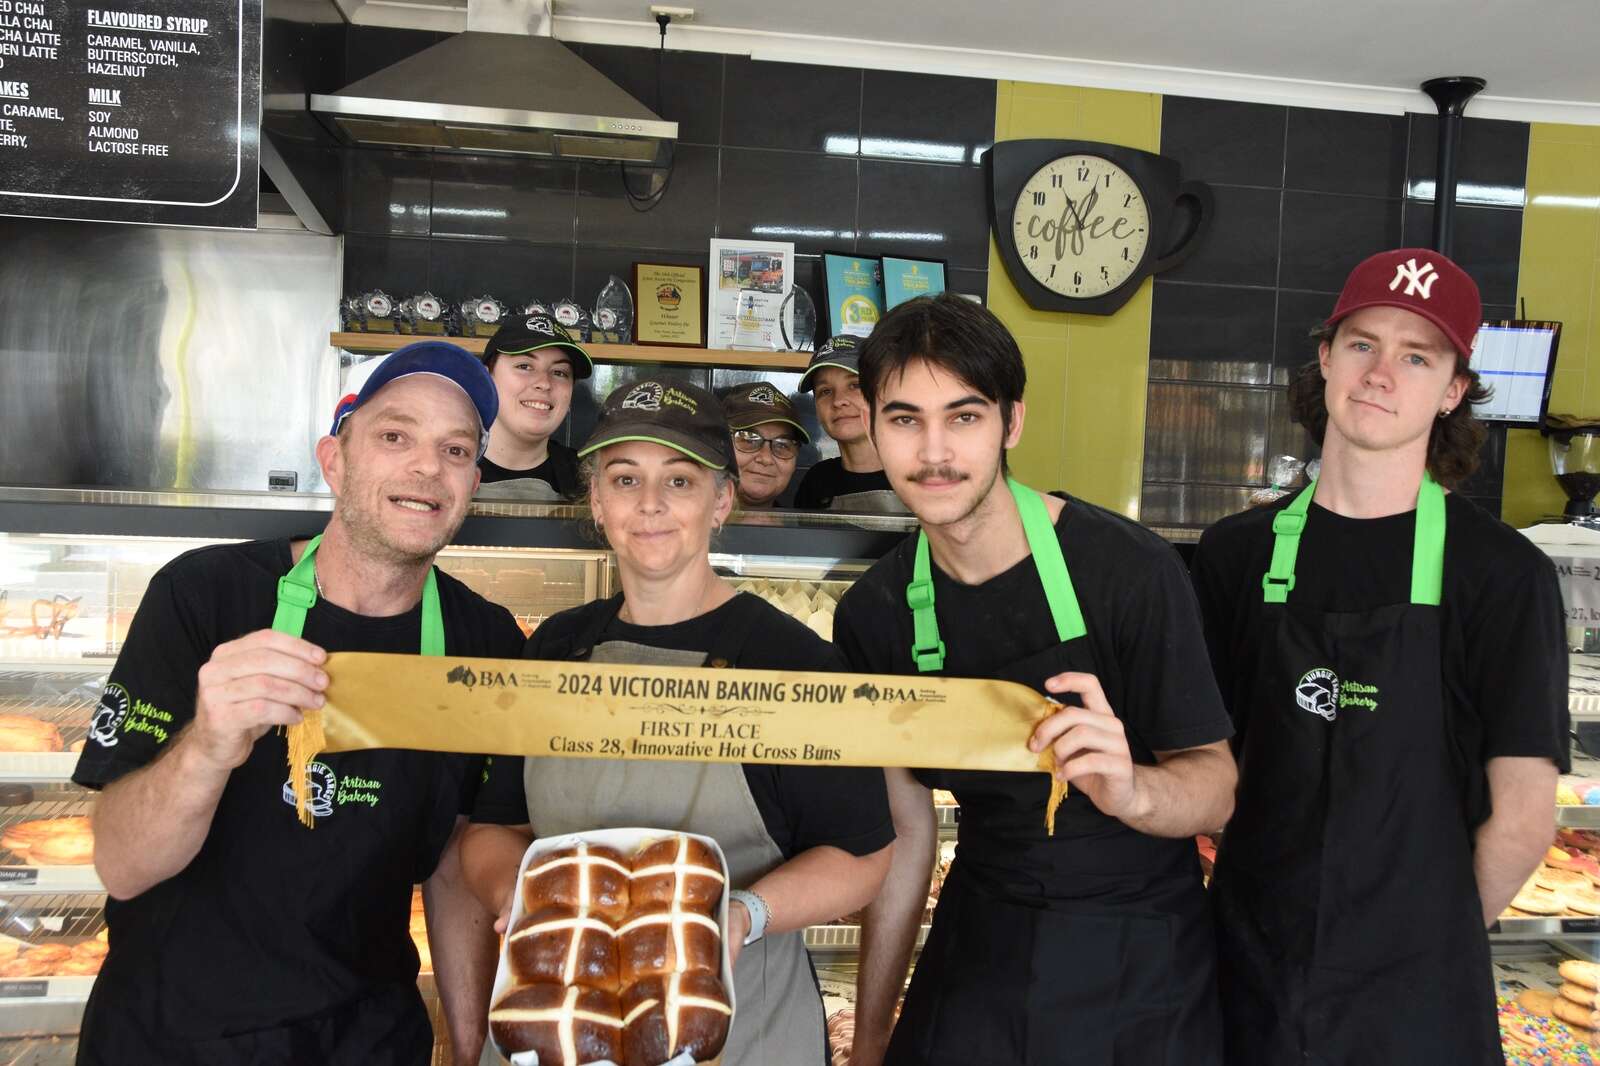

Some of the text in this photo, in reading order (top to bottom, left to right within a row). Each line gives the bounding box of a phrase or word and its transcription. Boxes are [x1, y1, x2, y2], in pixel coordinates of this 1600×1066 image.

[15, 2, 44, 16] CHAI
[24, 17, 52, 31] CHAI
[87, 9, 208, 33] FLAVOURED SYRUP
[26, 32, 61, 46] LATTE
[87, 35, 201, 55] CARAMEL, VANILLA,
[23, 45, 58, 60] LATTE
[87, 50, 179, 67] BUTTERSCOTCH,
[87, 64, 147, 77] HAZELNUT
[88, 87, 121, 104] MILK
[3, 104, 64, 121] CARAMEL,
[88, 111, 111, 123] SOY
[88, 127, 139, 140] ALMOND
[88, 141, 169, 157] LACTOSE FREE
[1051, 174, 1063, 188] 11
[1077, 167, 1089, 182] 12
[1104, 175, 1110, 188] 1
[1032, 191, 1046, 206] 10
[1123, 193, 1131, 208] 2
[1027, 191, 1136, 261] coffee
[1030, 245, 1038, 260] 8
[1121, 247, 1129, 261] 4
[1049, 264, 1056, 278] 7
[1073, 271, 1082, 285] 6
[1100, 266, 1109, 280] 5
[480, 670, 519, 688] BAA
[1340, 680, 1378, 693] Artisan
[557, 673, 603, 695] 2024
[609, 676, 710, 700] VICTORIAN
[716, 681, 785, 702] BAKING
[791, 683, 847, 704] SHOW
[882, 687, 917, 702] BAA
[1339, 694, 1378, 711] Bakery
[131, 699, 173, 722] Artisan
[124, 717, 168, 743] Bakery
[640, 721, 761, 740] FIRST PLACE
[550, 736, 841, 761] Class 28, Innovative Hot Cross Buns
[339, 775, 382, 790] Artisan
[337, 790, 379, 807] Bakery
